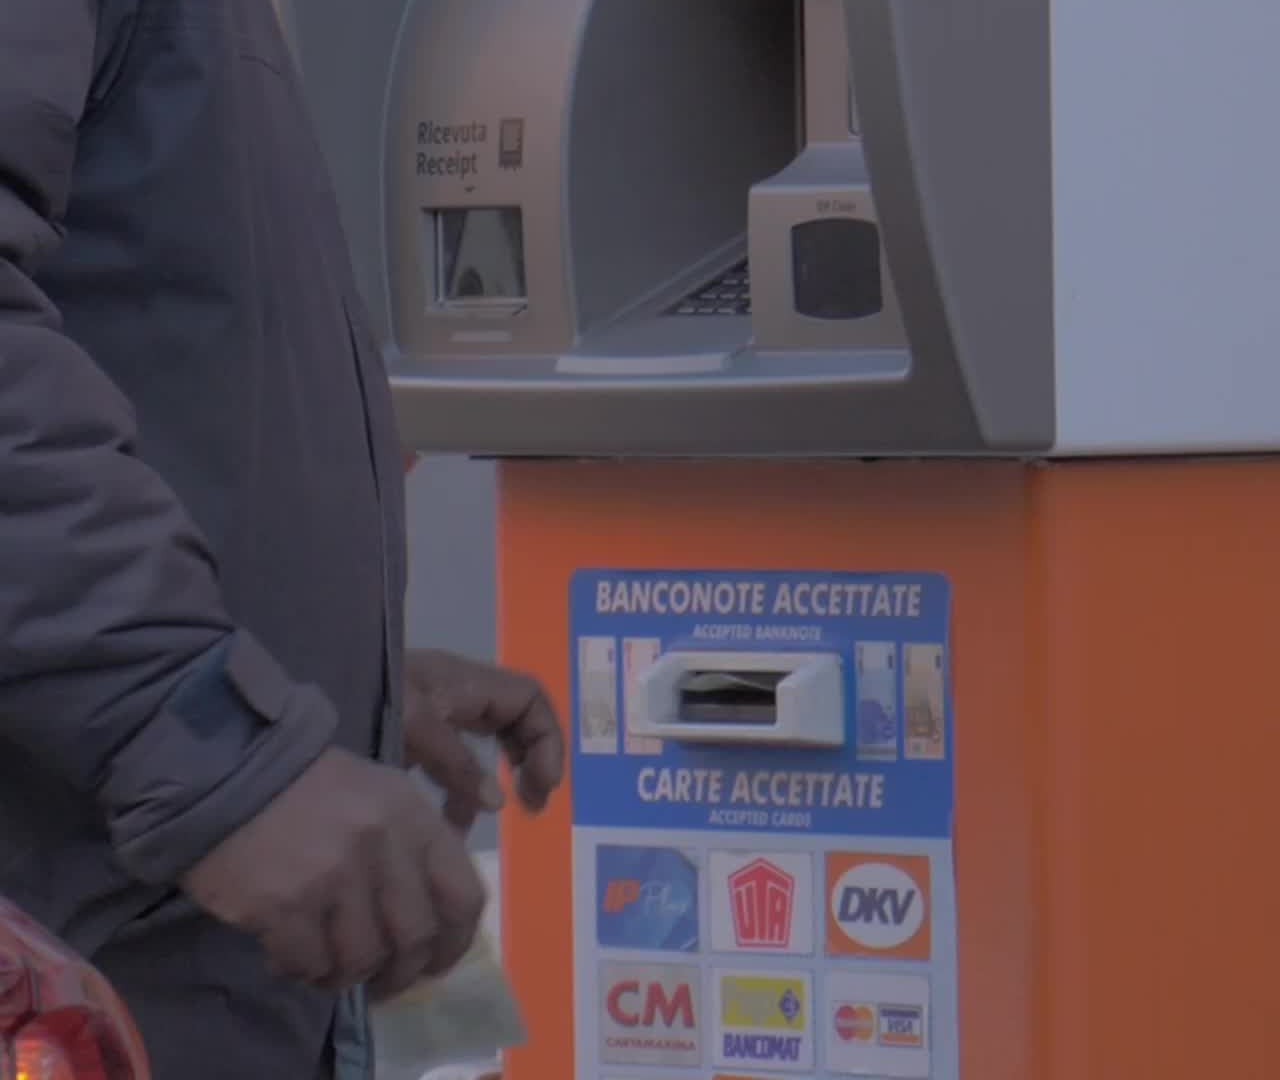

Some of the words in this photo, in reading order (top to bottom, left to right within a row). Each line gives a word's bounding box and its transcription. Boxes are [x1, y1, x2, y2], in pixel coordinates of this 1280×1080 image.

[417, 120, 487, 144] Ricevuta
[416, 151, 478, 180] Receipt
[596, 581, 765, 615] BANCONOTE
[773, 582, 922, 617] ACCETTATE
[638, 768, 722, 803] CARTE
[730, 771, 885, 809] ACCETTATE
[708, 809, 768, 827] ACCEPTED
[602, 879, 642, 913] IP
[728, 857, 795, 948] UTA
[837, 886, 916, 926] DKV
[607, 980, 696, 1028] CM
[722, 1032, 803, 1062] BANCOMAT
